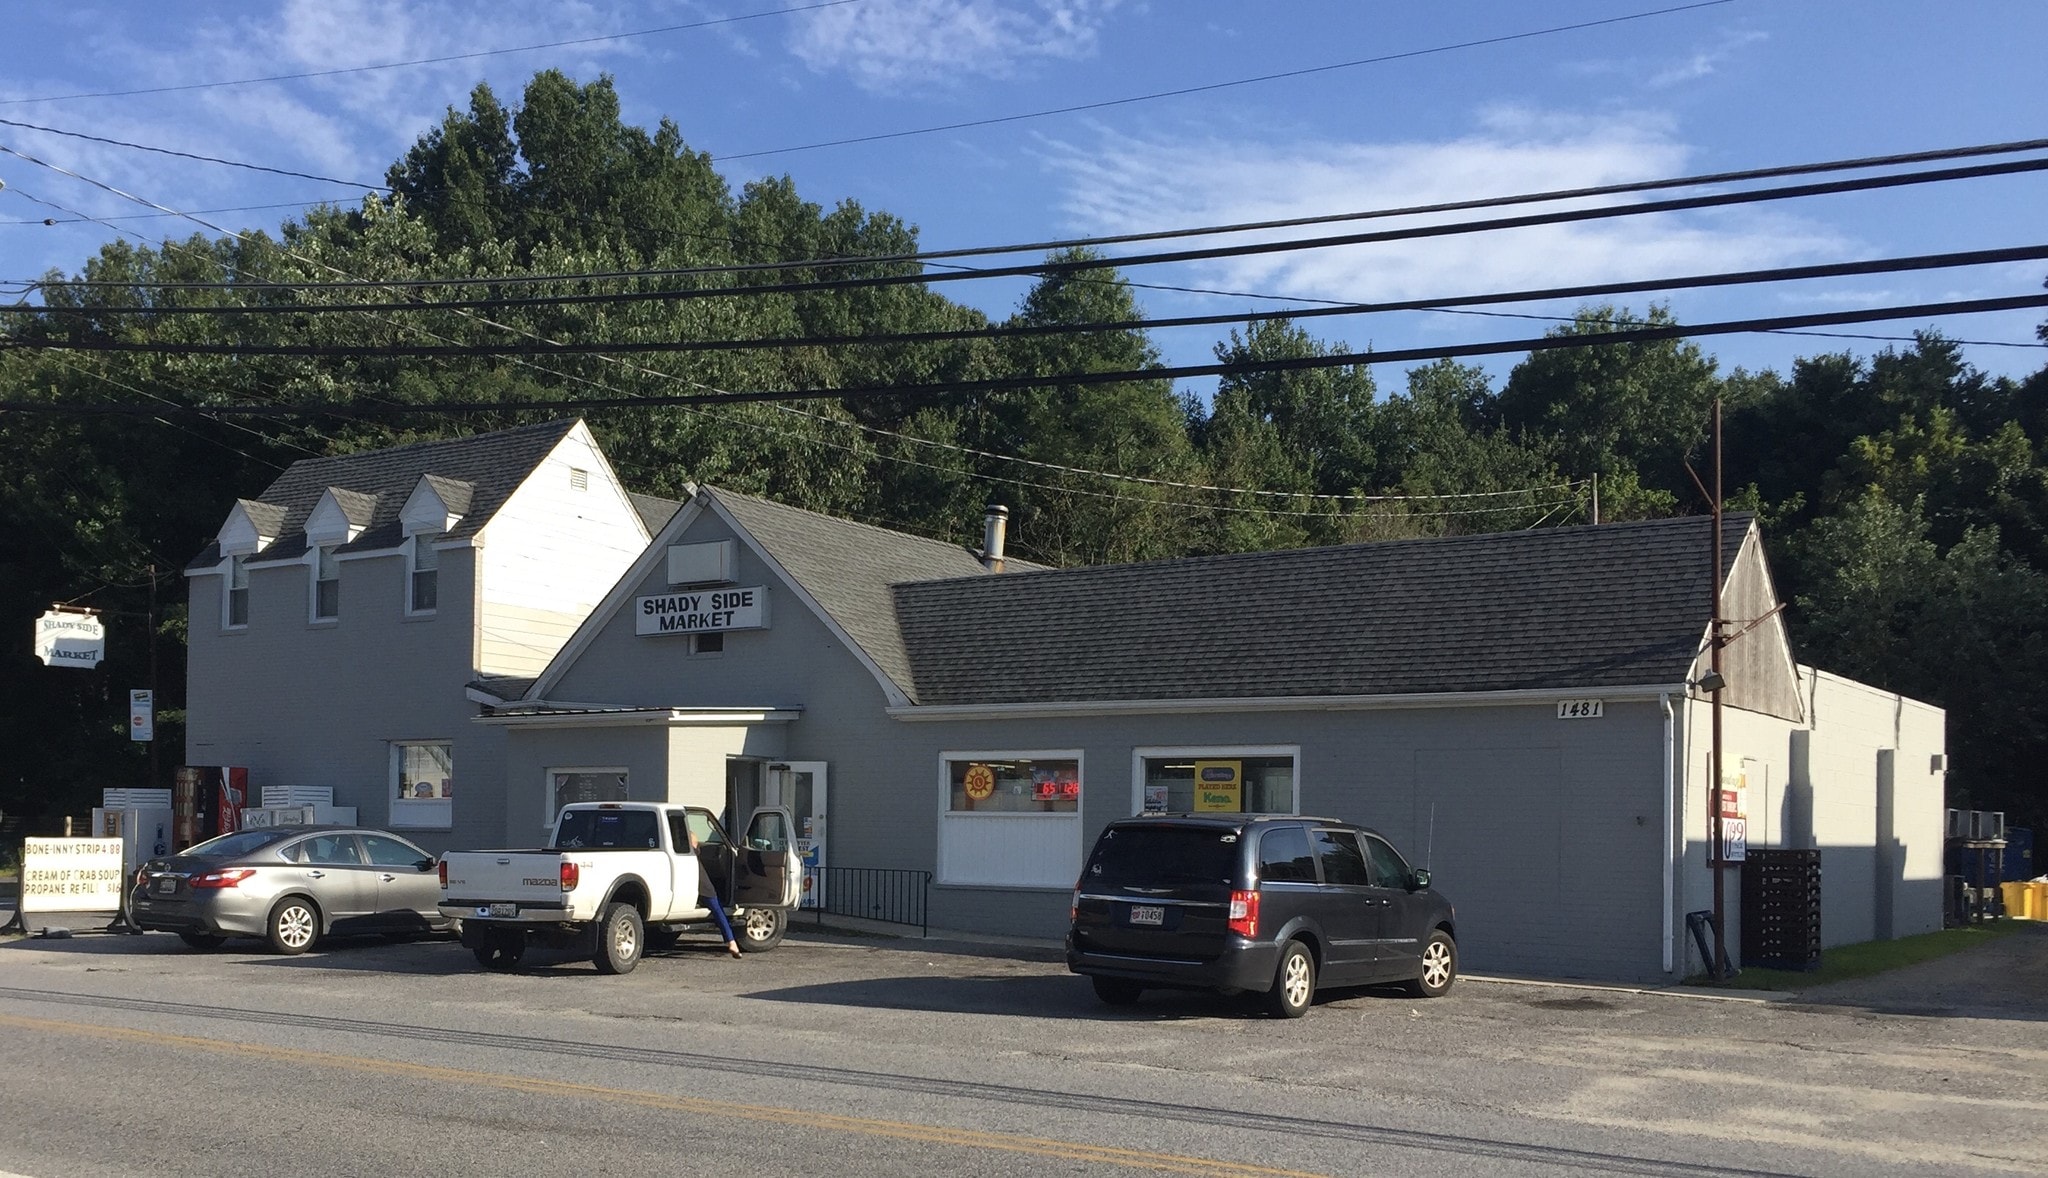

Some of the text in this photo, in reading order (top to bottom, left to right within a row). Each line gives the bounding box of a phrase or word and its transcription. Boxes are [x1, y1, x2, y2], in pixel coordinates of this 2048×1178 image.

[643, 591, 753, 615] SHADY SIDE
[43, 618, 99, 636] SHADY SIDE
[660, 611, 735, 631] MARKET
[43, 645, 99, 661] MARKET
[1561, 702, 1599, 716] 1481
[1043, 782, 1056, 795] 65
[75, 843, 99, 855] STRIP
[25, 869, 120, 881] CREAM OF CRAB SOUP
[24, 883, 66, 895] PROPANE
[107, 882, 121, 893] $16
[522, 877, 558, 887] mazda
